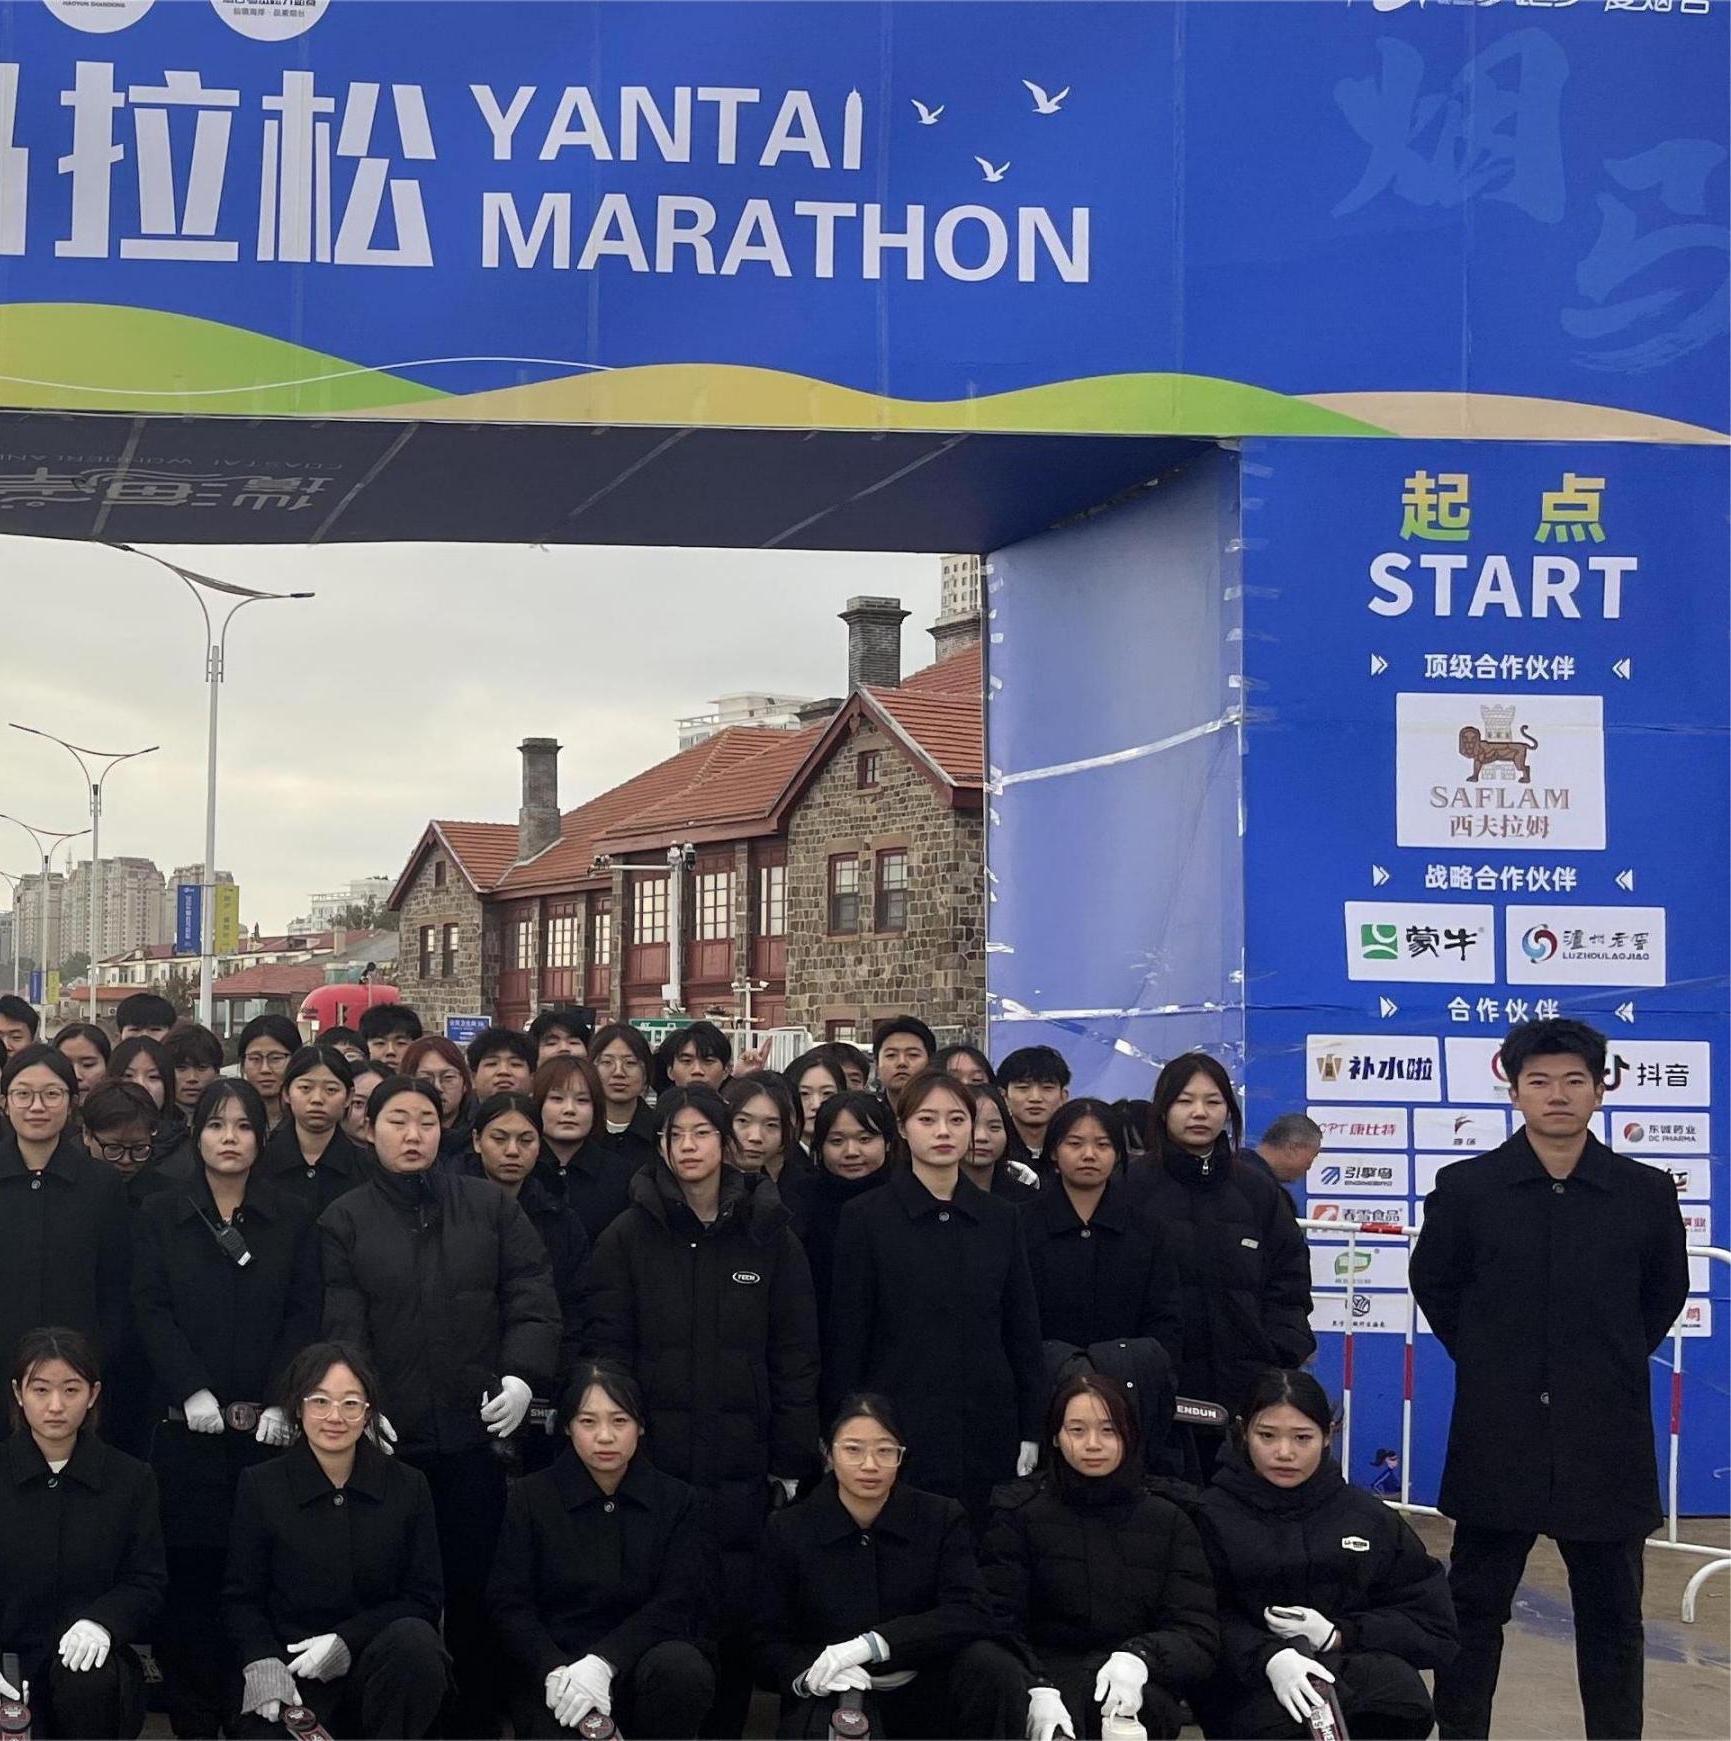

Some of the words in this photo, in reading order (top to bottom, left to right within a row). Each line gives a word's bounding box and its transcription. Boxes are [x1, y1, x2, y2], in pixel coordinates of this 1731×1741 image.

[469, 84, 865, 170] YANTAI
[480, 191, 1091, 283] MARATHON
[1399, 470, 1607, 544] 起点
[1368, 552, 1638, 620] START
[1424, 653, 1576, 681] 顶级合作伙伴
[1429, 786, 1570, 810] SAFLAM
[1450, 815, 1550, 839] 西夫拉姆
[1424, 865, 1578, 892] 战略合作伙伴
[1405, 924, 1478, 961] 蒙牛
[1562, 952, 1650, 961] LUZHOULAOJIAO
[1447, 996, 1561, 1024] 合作伙伴
[1349, 1055, 1433, 1081] 补水啦
[1637, 1062, 1690, 1088] 抖音
[1648, 1124, 1696, 1135] 东诚药业
[1662, 1135, 1697, 1143] PHARMA
